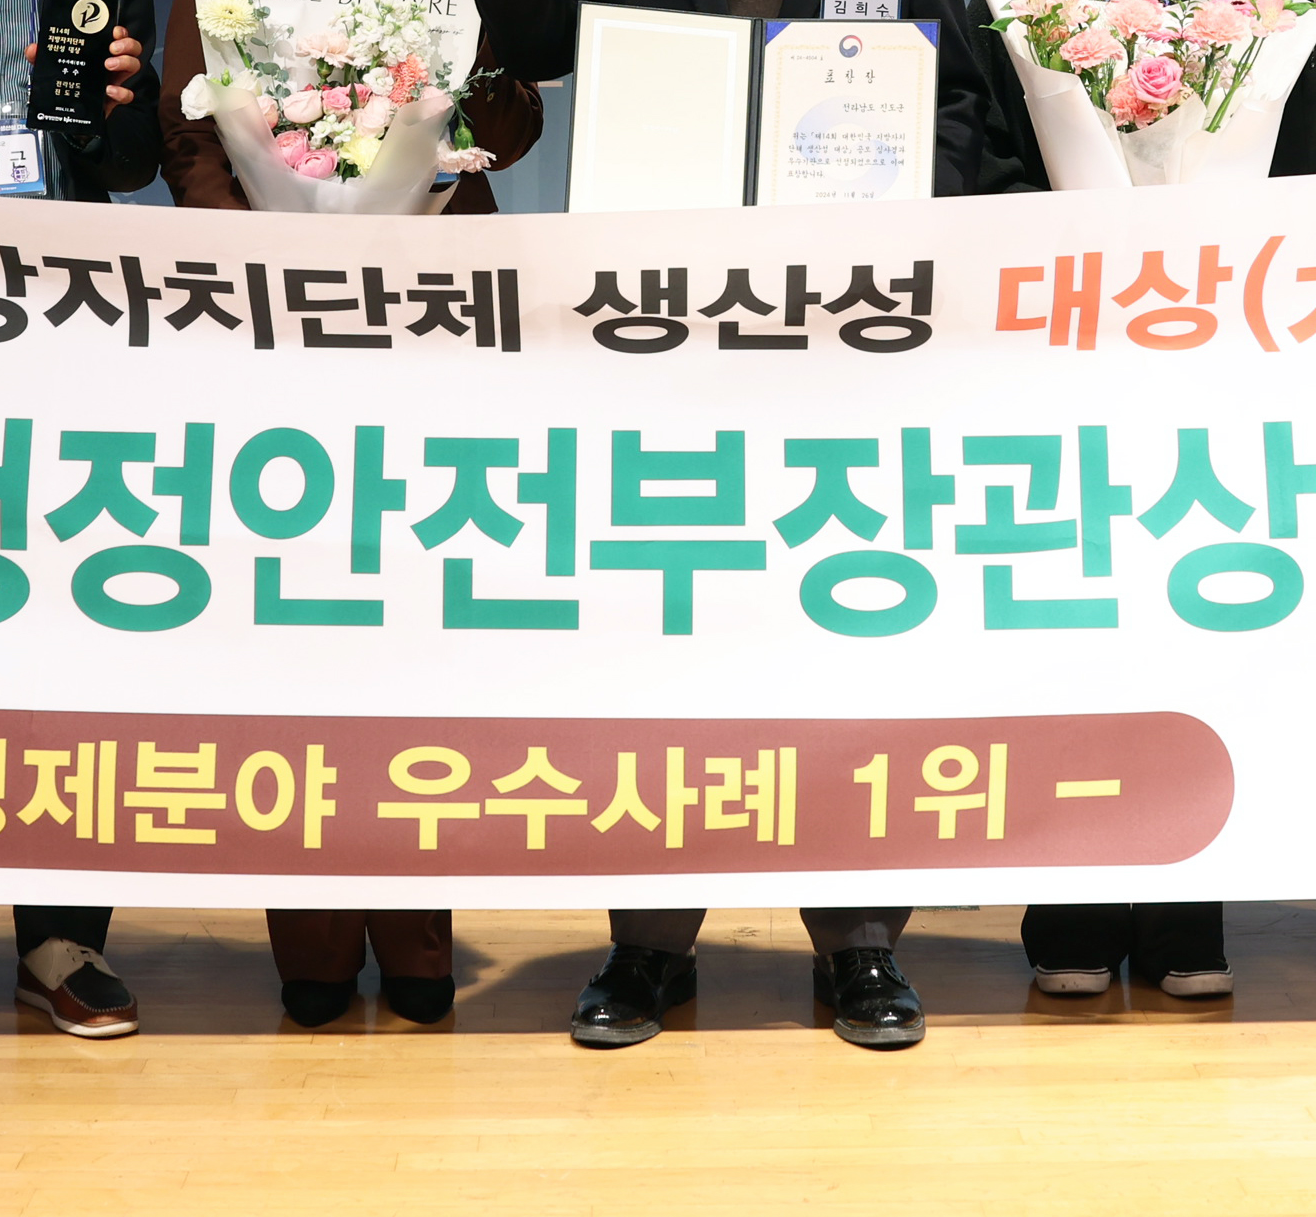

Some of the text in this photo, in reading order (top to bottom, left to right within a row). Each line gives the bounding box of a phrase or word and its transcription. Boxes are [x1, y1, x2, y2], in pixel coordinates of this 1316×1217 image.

[49, 26, 70, 35] 제14회
[48, 35, 85, 46] 지방자치단체
[47, 44, 66, 54] 생산성
[843, 102, 905, 113] 전라남도 진도군
[842, 132, 872, 141] 대한민국
[876, 132, 905, 141] 지방자치
[572, 260, 934, 354] 생산성
[376, 743, 795, 851] 우수사례
[851, 740, 1009, 844] 1위
